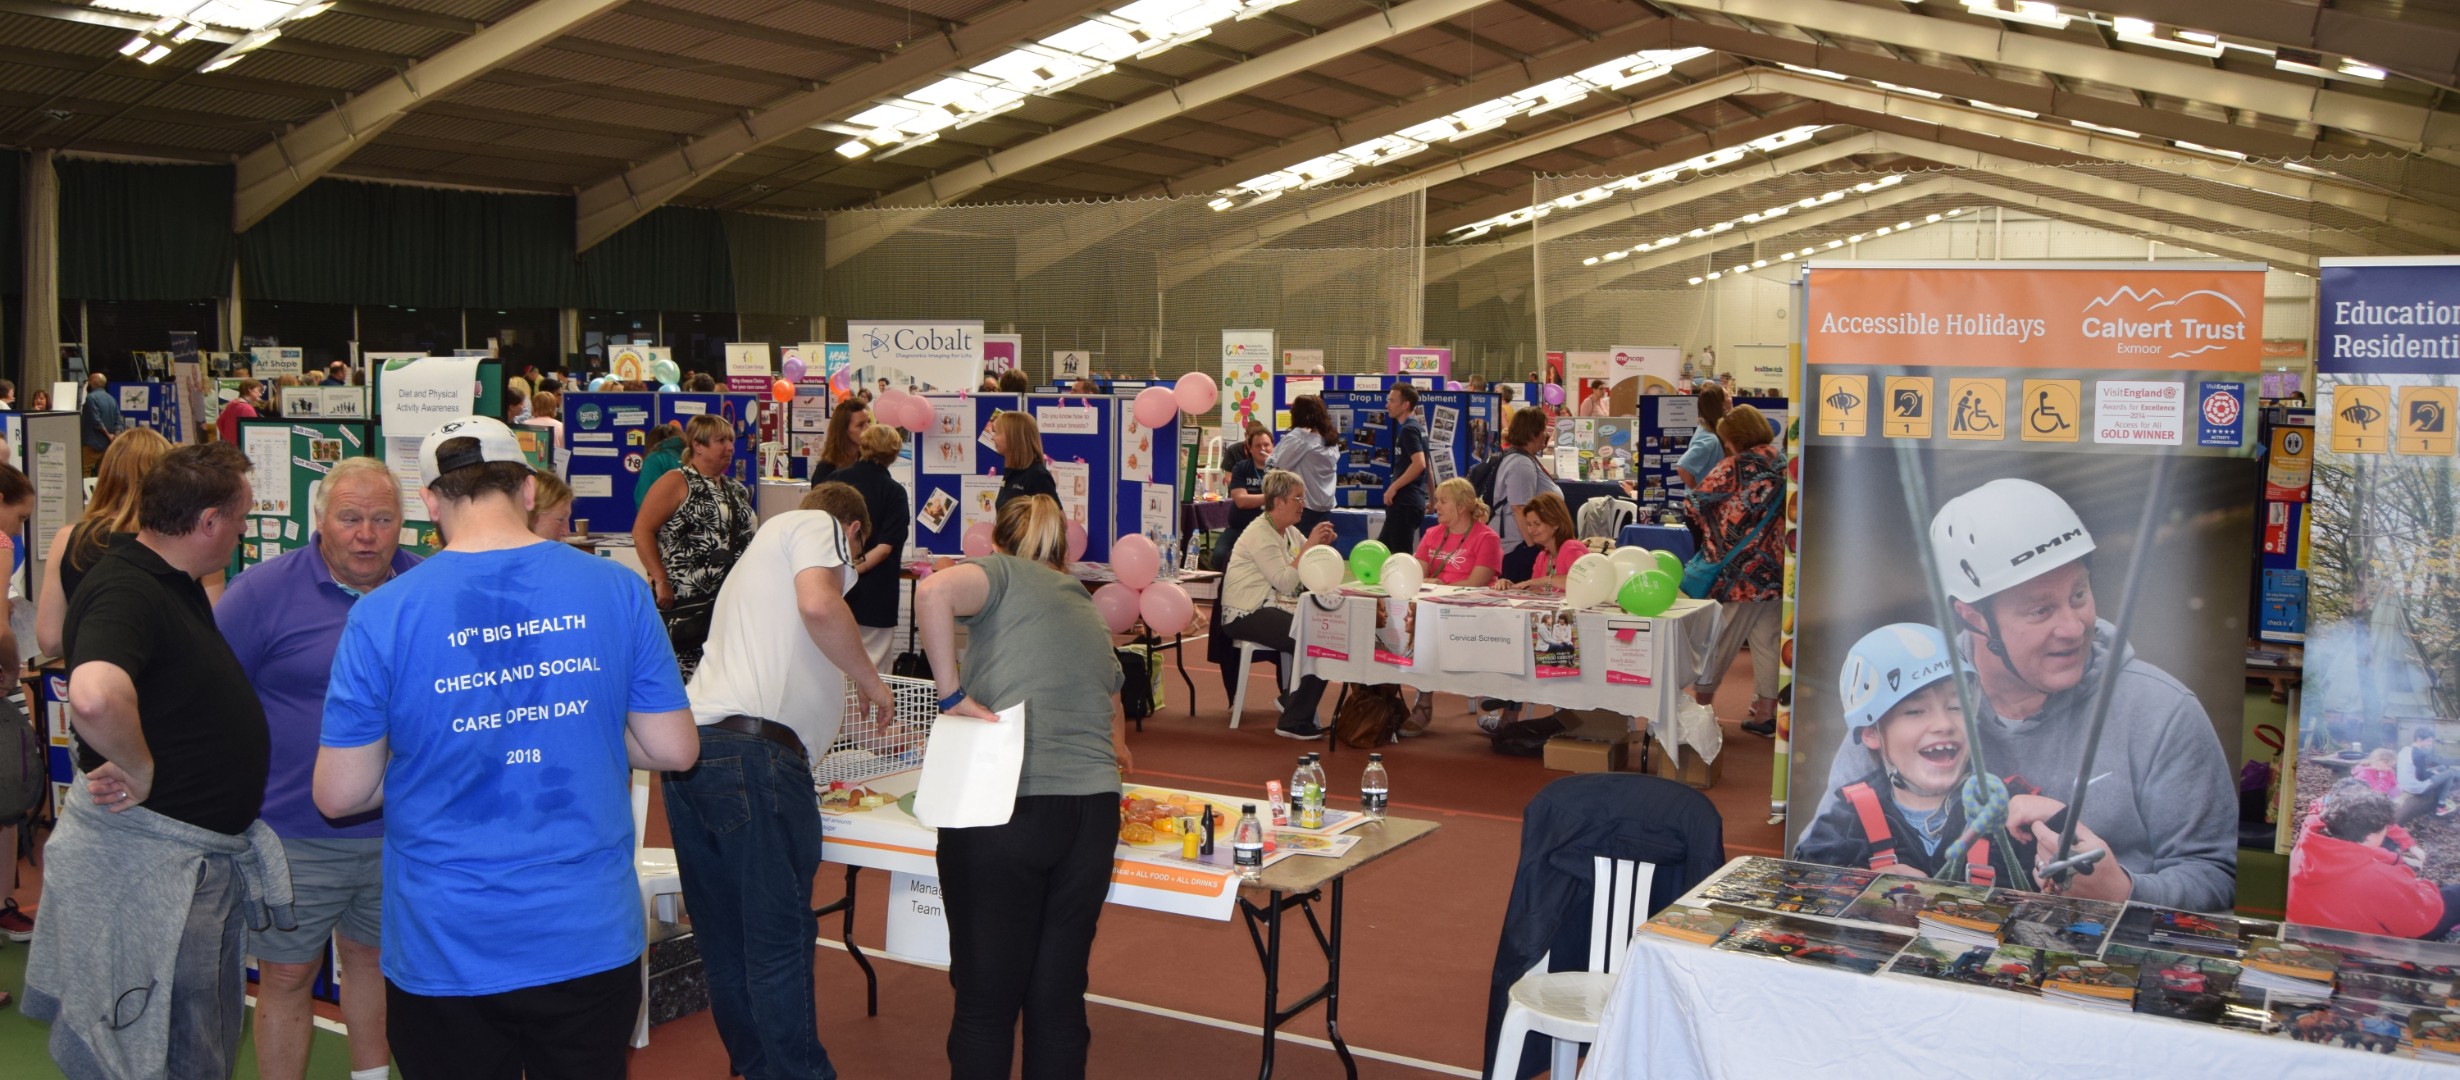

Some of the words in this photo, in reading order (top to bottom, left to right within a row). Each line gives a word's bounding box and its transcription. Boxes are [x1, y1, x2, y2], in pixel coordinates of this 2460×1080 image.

[1820, 311, 1939, 335] Accessible
[1946, 313, 2045, 343] Holidays
[2082, 317, 2173, 338] Calvert
[2180, 318, 2246, 340] Trust
[894, 328, 972, 351] Cobalt
[2117, 343, 2162, 354] Exmoor
[2333, 333, 2460, 358] Residenti
[829, 351, 849, 360] HEAL
[1616, 355, 1644, 363] mencap
[271, 360, 298, 368] Shape
[1754, 365, 1783, 373] healthwatch
[399, 389, 412, 397] Diet
[414, 389, 426, 397] and
[428, 389, 458, 400] Physical
[1350, 393, 1371, 403] Drop
[1374, 394, 1382, 402] In
[2103, 388, 2162, 398] VisitEngland
[396, 404, 419, 413] Activity
[421, 404, 459, 412] Awareness
[2102, 403, 2127, 411] Awards
[2129, 403, 2139, 411] for
[580, 415, 598, 423] group
[1839, 422, 1845, 431] 1
[1904, 424, 1910, 433] 1
[2114, 421, 2138, 429] Access
[2140, 421, 2150, 429] for
[2101, 429, 2130, 439] GOLD
[2132, 430, 2175, 440] WINNER
[2356, 438, 2362, 448] 1
[2421, 440, 2428, 450] 1
[2010, 528, 2082, 567] DMM
[1321, 618, 1329, 631] 5
[2267, 619, 2283, 627] check
[448, 628, 479, 647] 10TH
[482, 625, 512, 643] BIG
[516, 614, 586, 637] HEALTH
[1449, 634, 1477, 642] Cervical
[1478, 634, 1511, 645] Screening
[1912, 658, 1953, 680] CAMP
[434, 671, 498, 694] CHECK
[500, 664, 534, 683] AND
[539, 657, 601, 677] SOCIAL
[452, 713, 502, 733] CARE
[506, 705, 549, 724] OPEN
[554, 699, 589, 718] DAY
[506, 748, 541, 765] 2018
[1136, 869, 1149, 879] ALL
[1149, 872, 1169, 881] FOOD
[1176, 876, 1190, 885] ALL
[1191, 878, 1218, 888] DRINKS
[911, 900, 941, 916] Team
